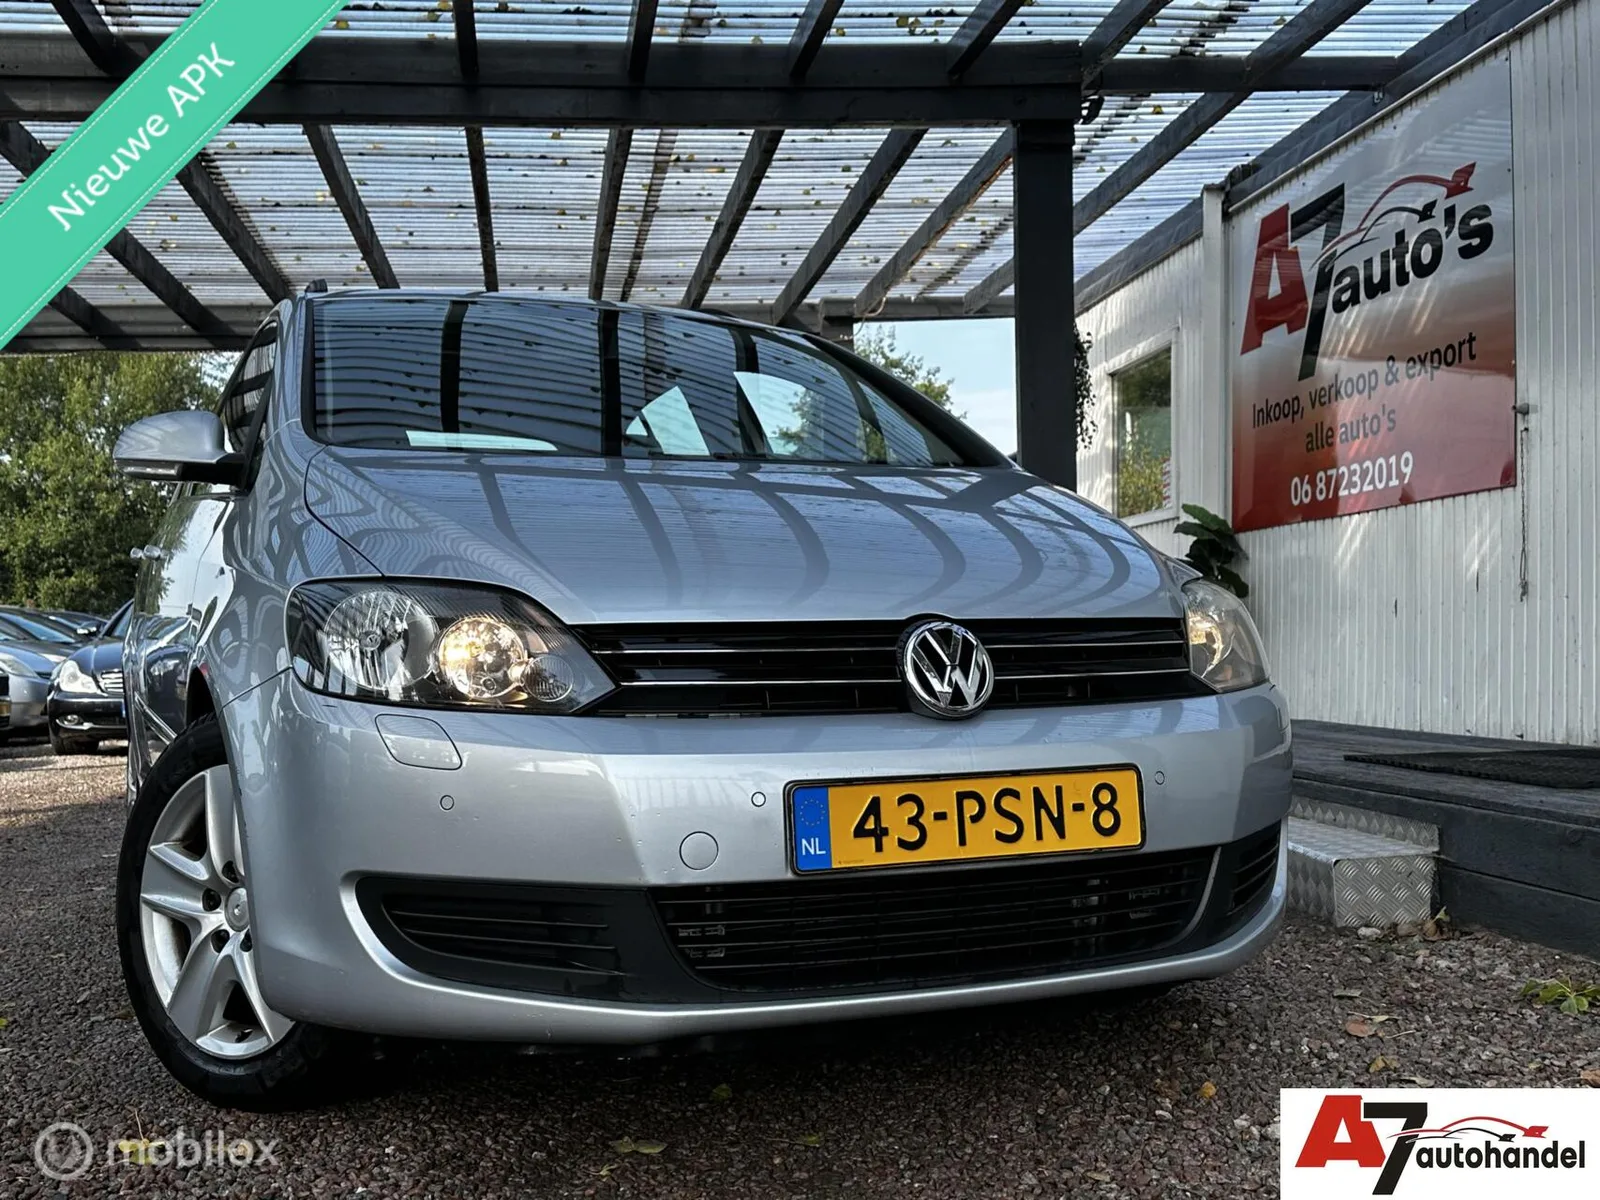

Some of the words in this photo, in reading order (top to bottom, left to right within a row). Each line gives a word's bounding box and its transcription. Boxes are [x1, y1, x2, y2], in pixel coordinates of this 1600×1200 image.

[1252, 395, 1305, 429] Inkoop,
[1308, 370, 1379, 409] verkoop
[1384, 355, 1400, 386] &
[1405, 332, 1477, 382] export
[1305, 423, 1335, 453] alle
[1339, 404, 1397, 445] auto's
[1291, 475, 1312, 506] 06
[1316, 450, 1414, 500] 87232019
[852, 782, 1122, 853] 43-PSN-8
[801, 838, 826, 856] NL
